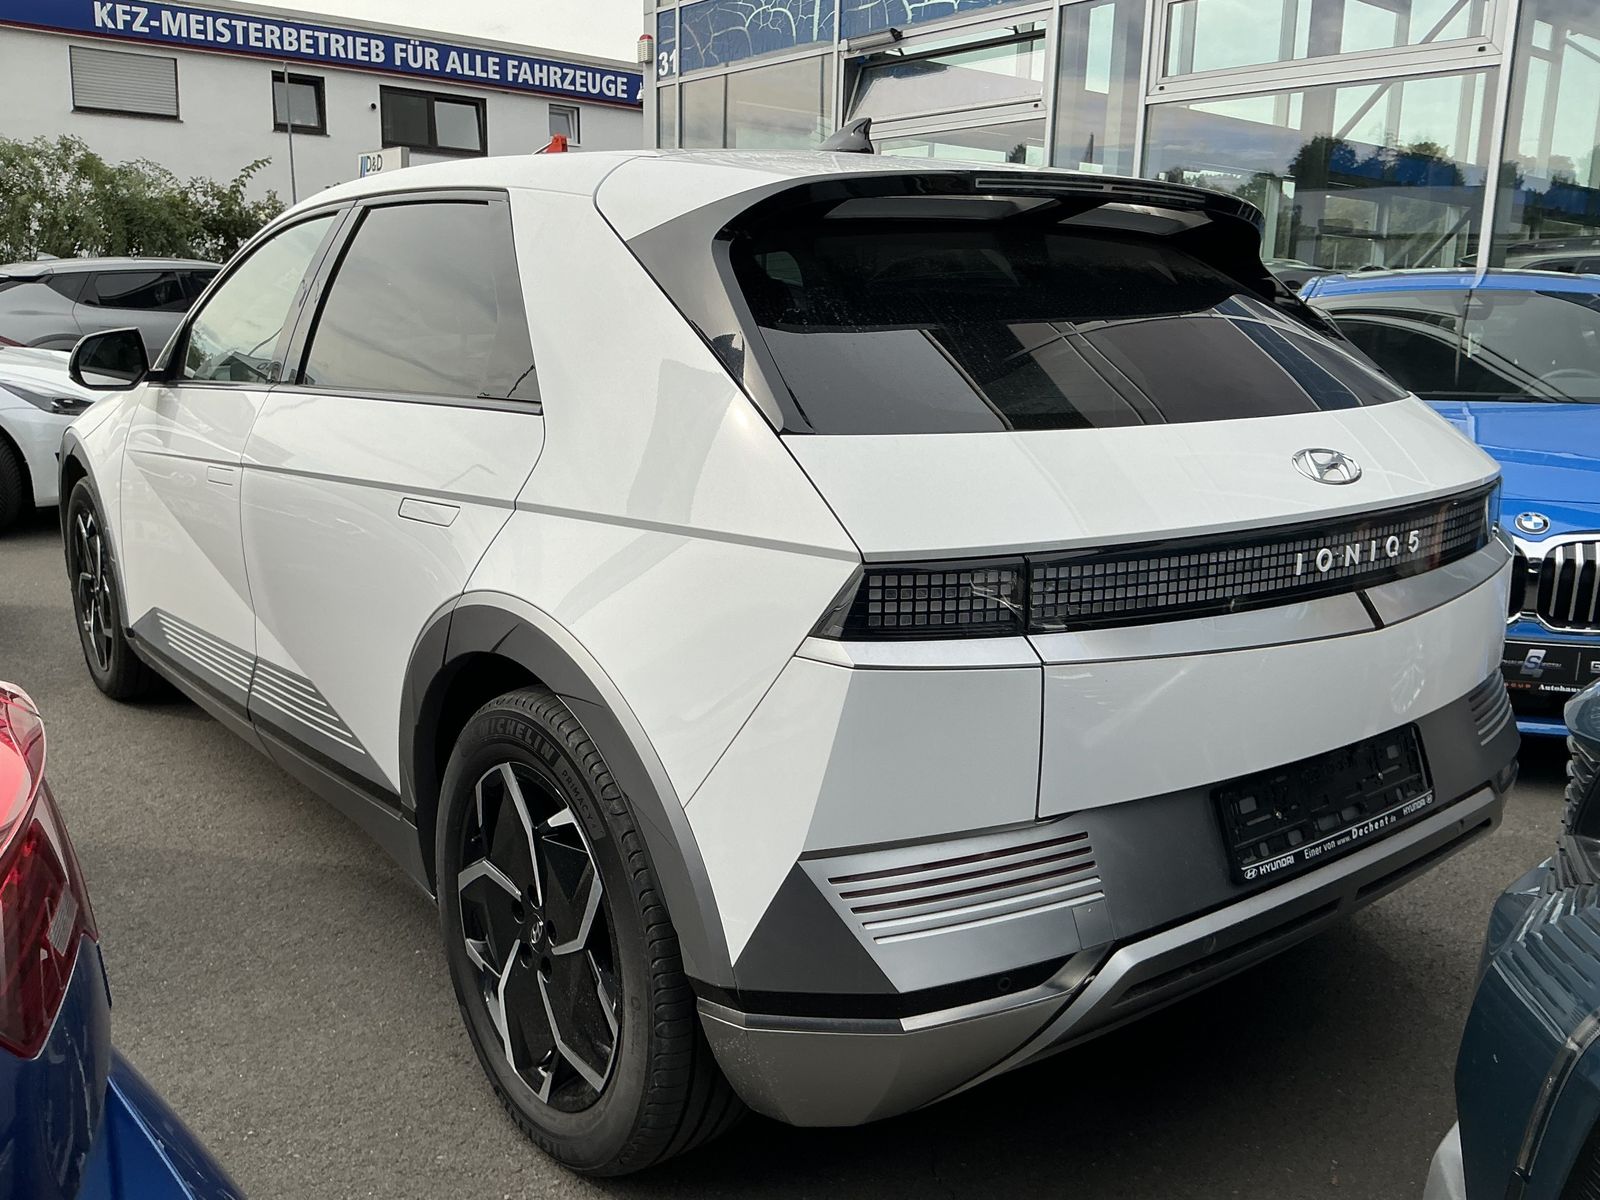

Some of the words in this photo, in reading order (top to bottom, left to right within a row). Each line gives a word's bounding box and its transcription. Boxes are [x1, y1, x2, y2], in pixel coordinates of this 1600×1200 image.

[93, 1, 386, 63] KFZ-MEISTERBETRIEB
[394, 40, 439, 71] FÜR
[445, 51, 500, 80] ALLE
[507, 59, 628, 98] FAHRZEUGE
[479, 718, 556, 760] MICHELIN
[562, 768, 594, 820] PRIMACY
[1259, 854, 1296, 876] HYUNDAI
[1303, 845, 1322, 860] Einer
[1322, 839, 1336, 852] von
